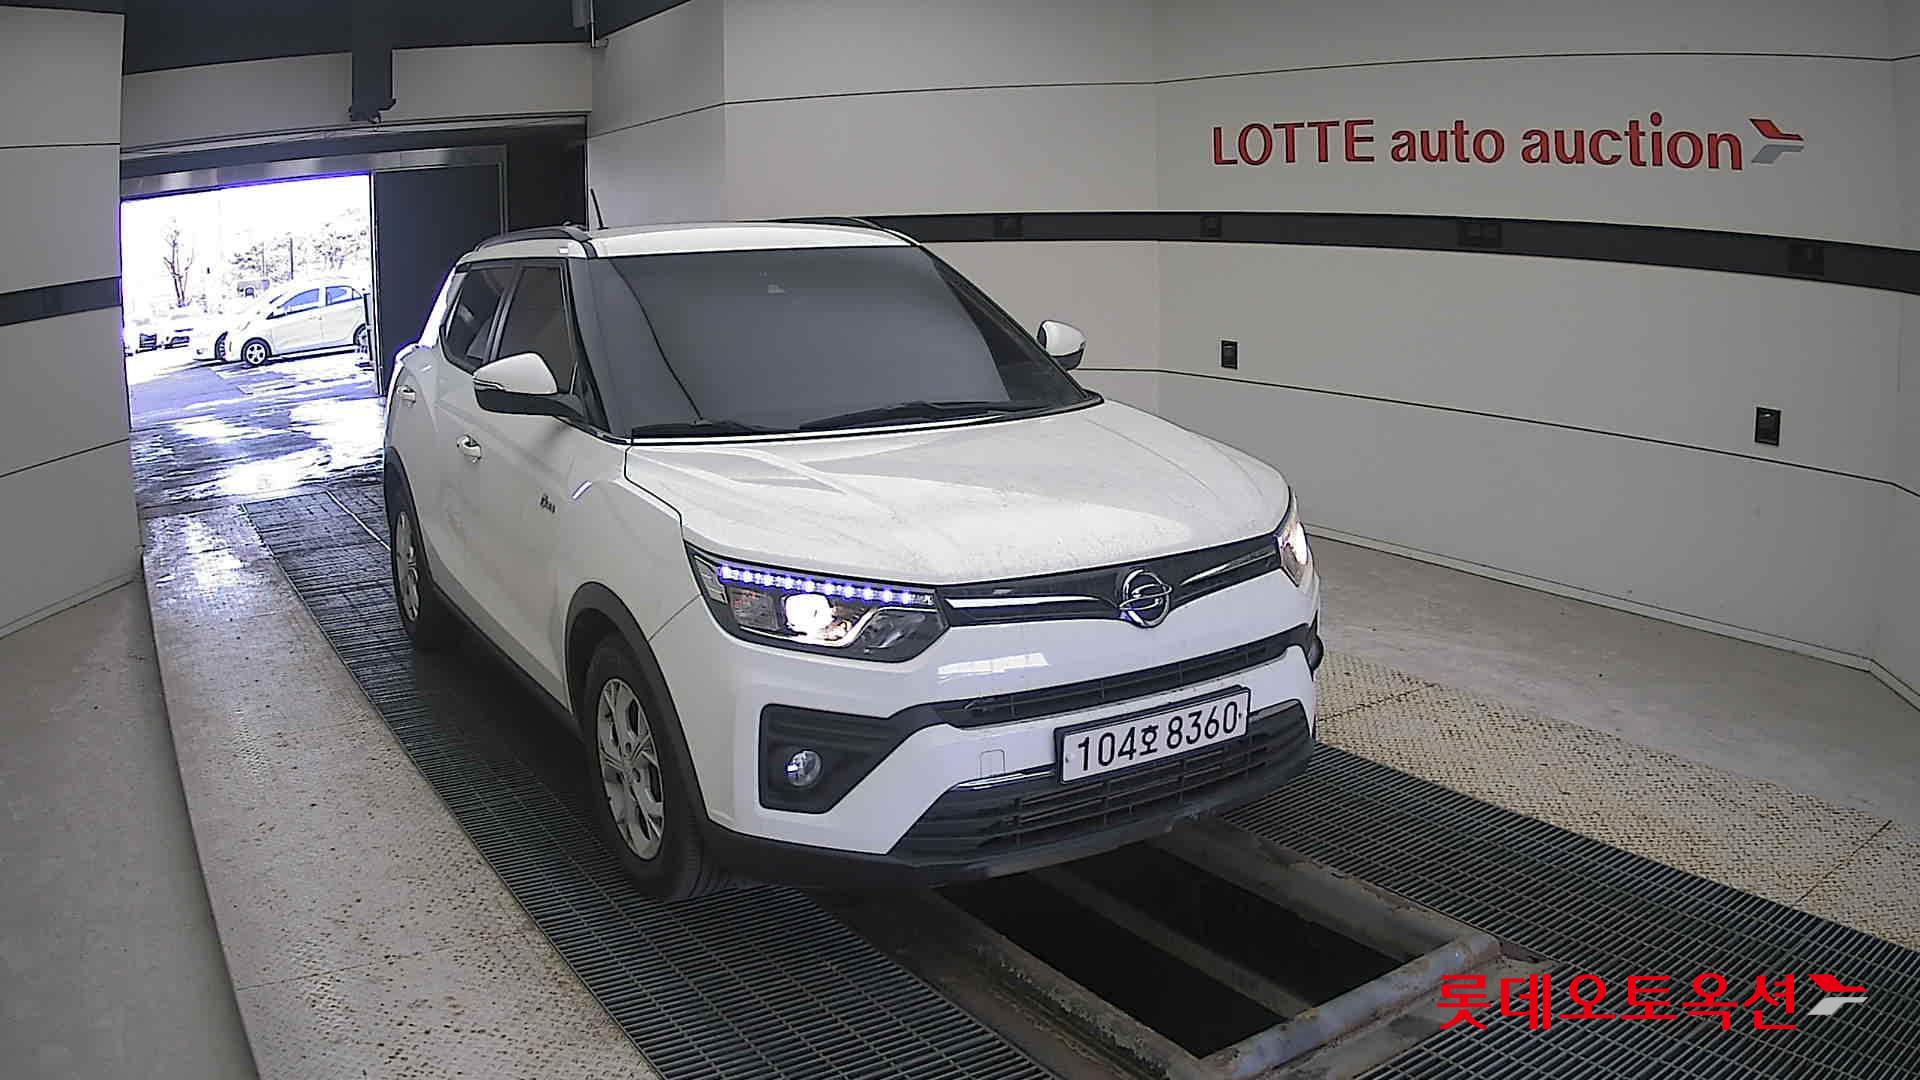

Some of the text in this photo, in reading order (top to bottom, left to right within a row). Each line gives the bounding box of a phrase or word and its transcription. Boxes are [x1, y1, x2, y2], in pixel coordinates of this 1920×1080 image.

[1212, 112, 1743, 171] LOTTE auto auction
[1078, 701, 1239, 771] 104호 8360
